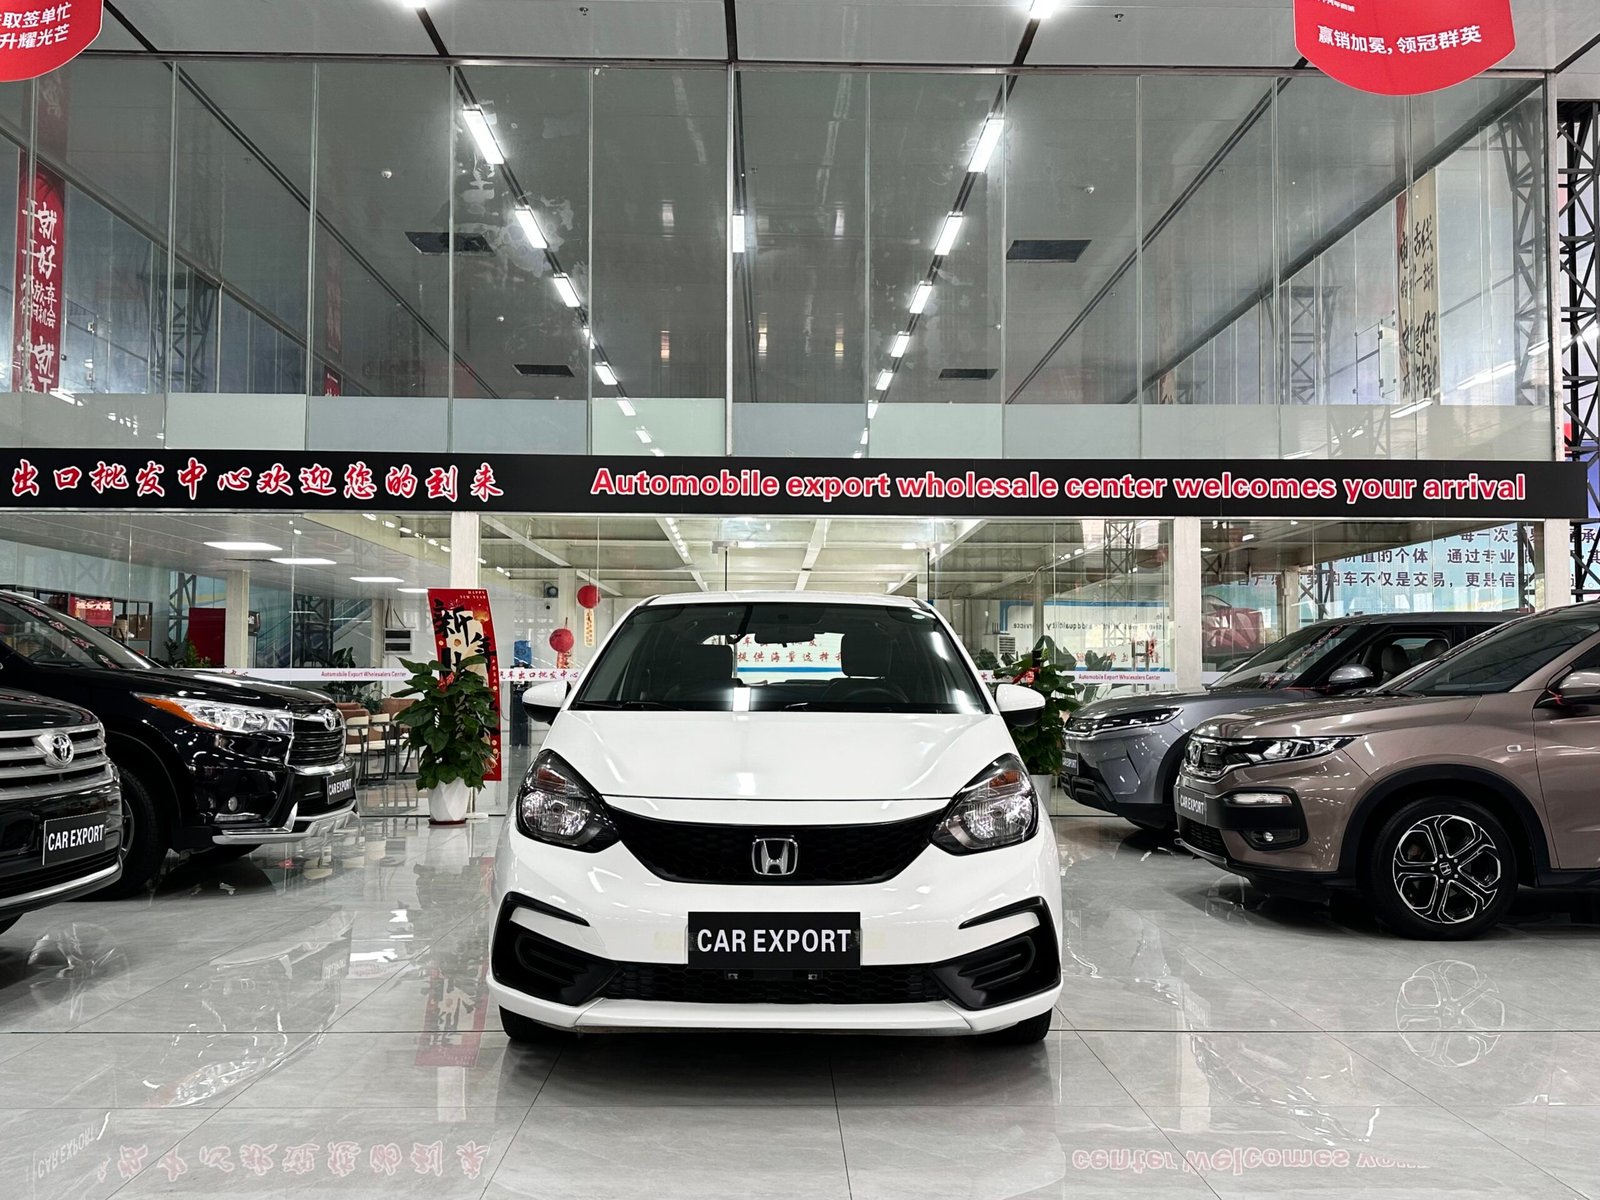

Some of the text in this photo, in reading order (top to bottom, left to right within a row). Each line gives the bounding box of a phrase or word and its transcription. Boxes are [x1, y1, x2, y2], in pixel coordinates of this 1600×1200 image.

[0, 2, 72, 28] 取签单忙
[11, 457, 504, 501] 出口批发中心欢迎您的到来
[591, 467, 1526, 504] Automobile export wholesale center welcomes your arrival
[47, 824, 105, 851] CAR EXPORT
[697, 929, 852, 952] CAR EXPORT
